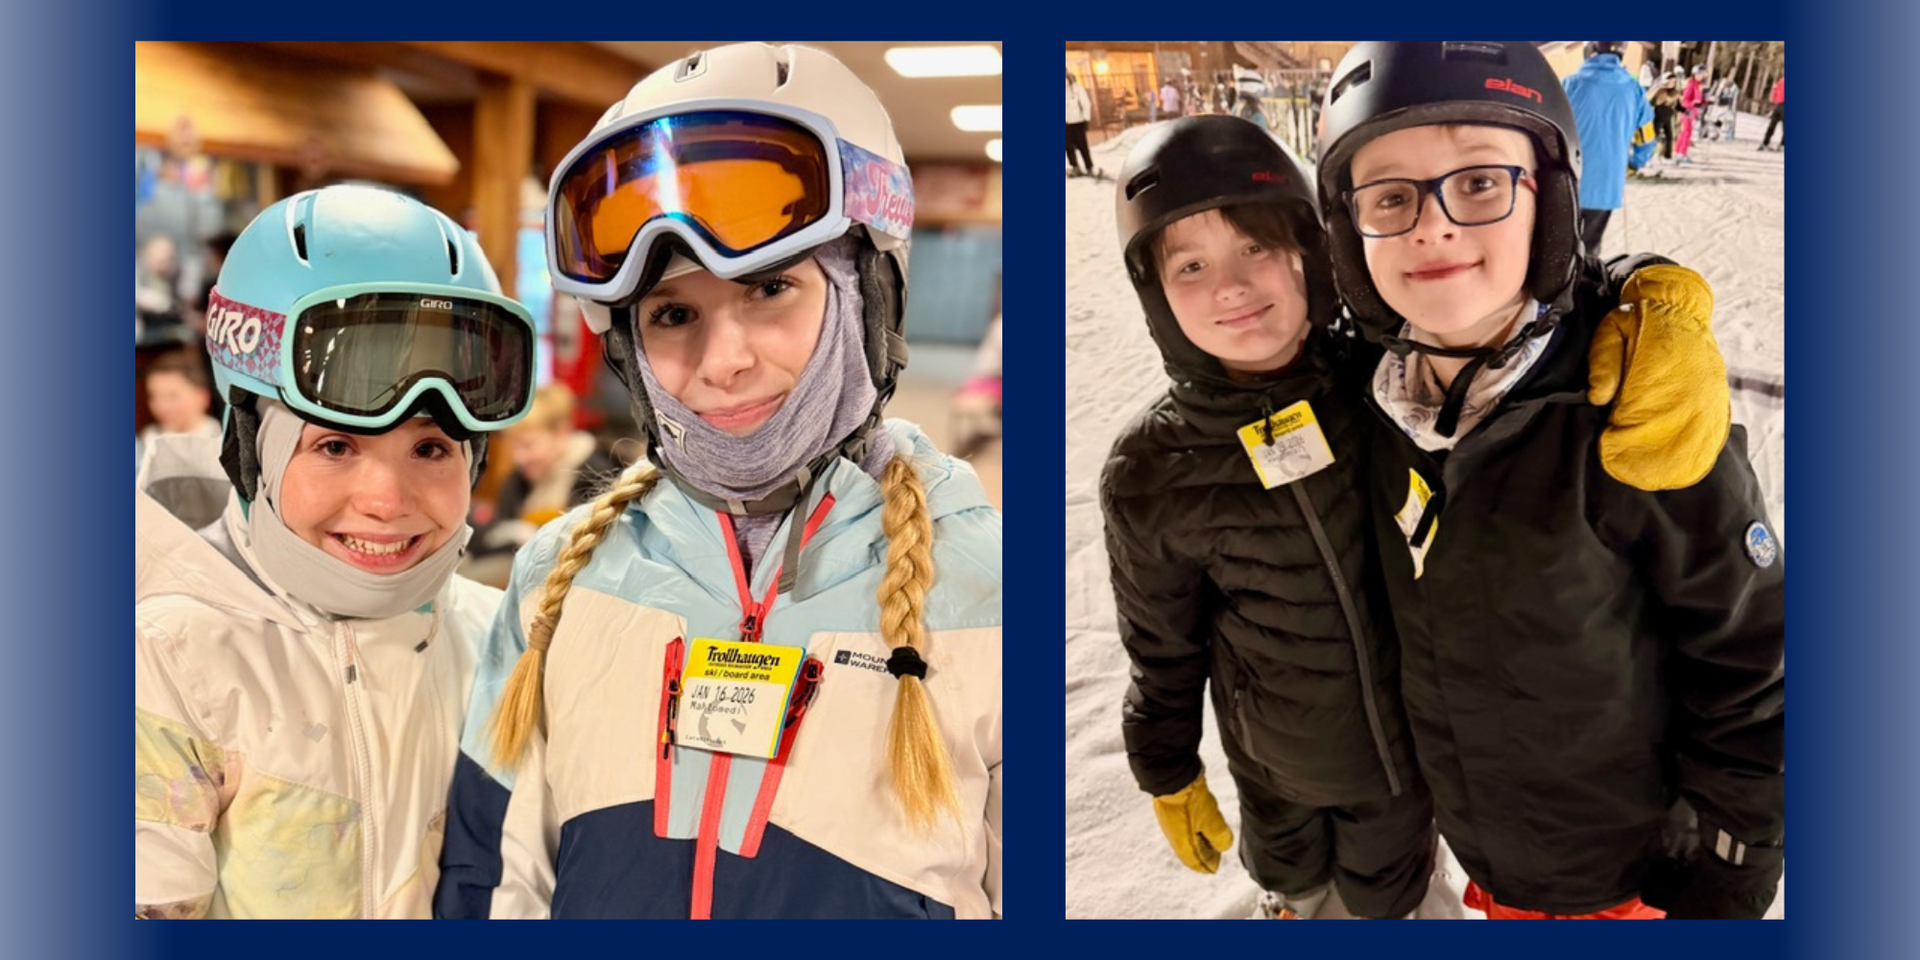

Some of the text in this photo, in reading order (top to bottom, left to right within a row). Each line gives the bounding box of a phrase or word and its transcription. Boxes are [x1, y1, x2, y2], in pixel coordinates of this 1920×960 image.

[1484, 77, 1543, 104] elan
[420, 298, 453, 310] GIRO
[207, 302, 262, 355] GIRO
[707, 645, 780, 668] Trollhaugen
[852, 651, 889, 664] MOUN
[704, 669, 716, 677] ski
[723, 670, 750, 680] board
[750, 672, 771, 681] area
[691, 685, 756, 704] JAN 16 2026
